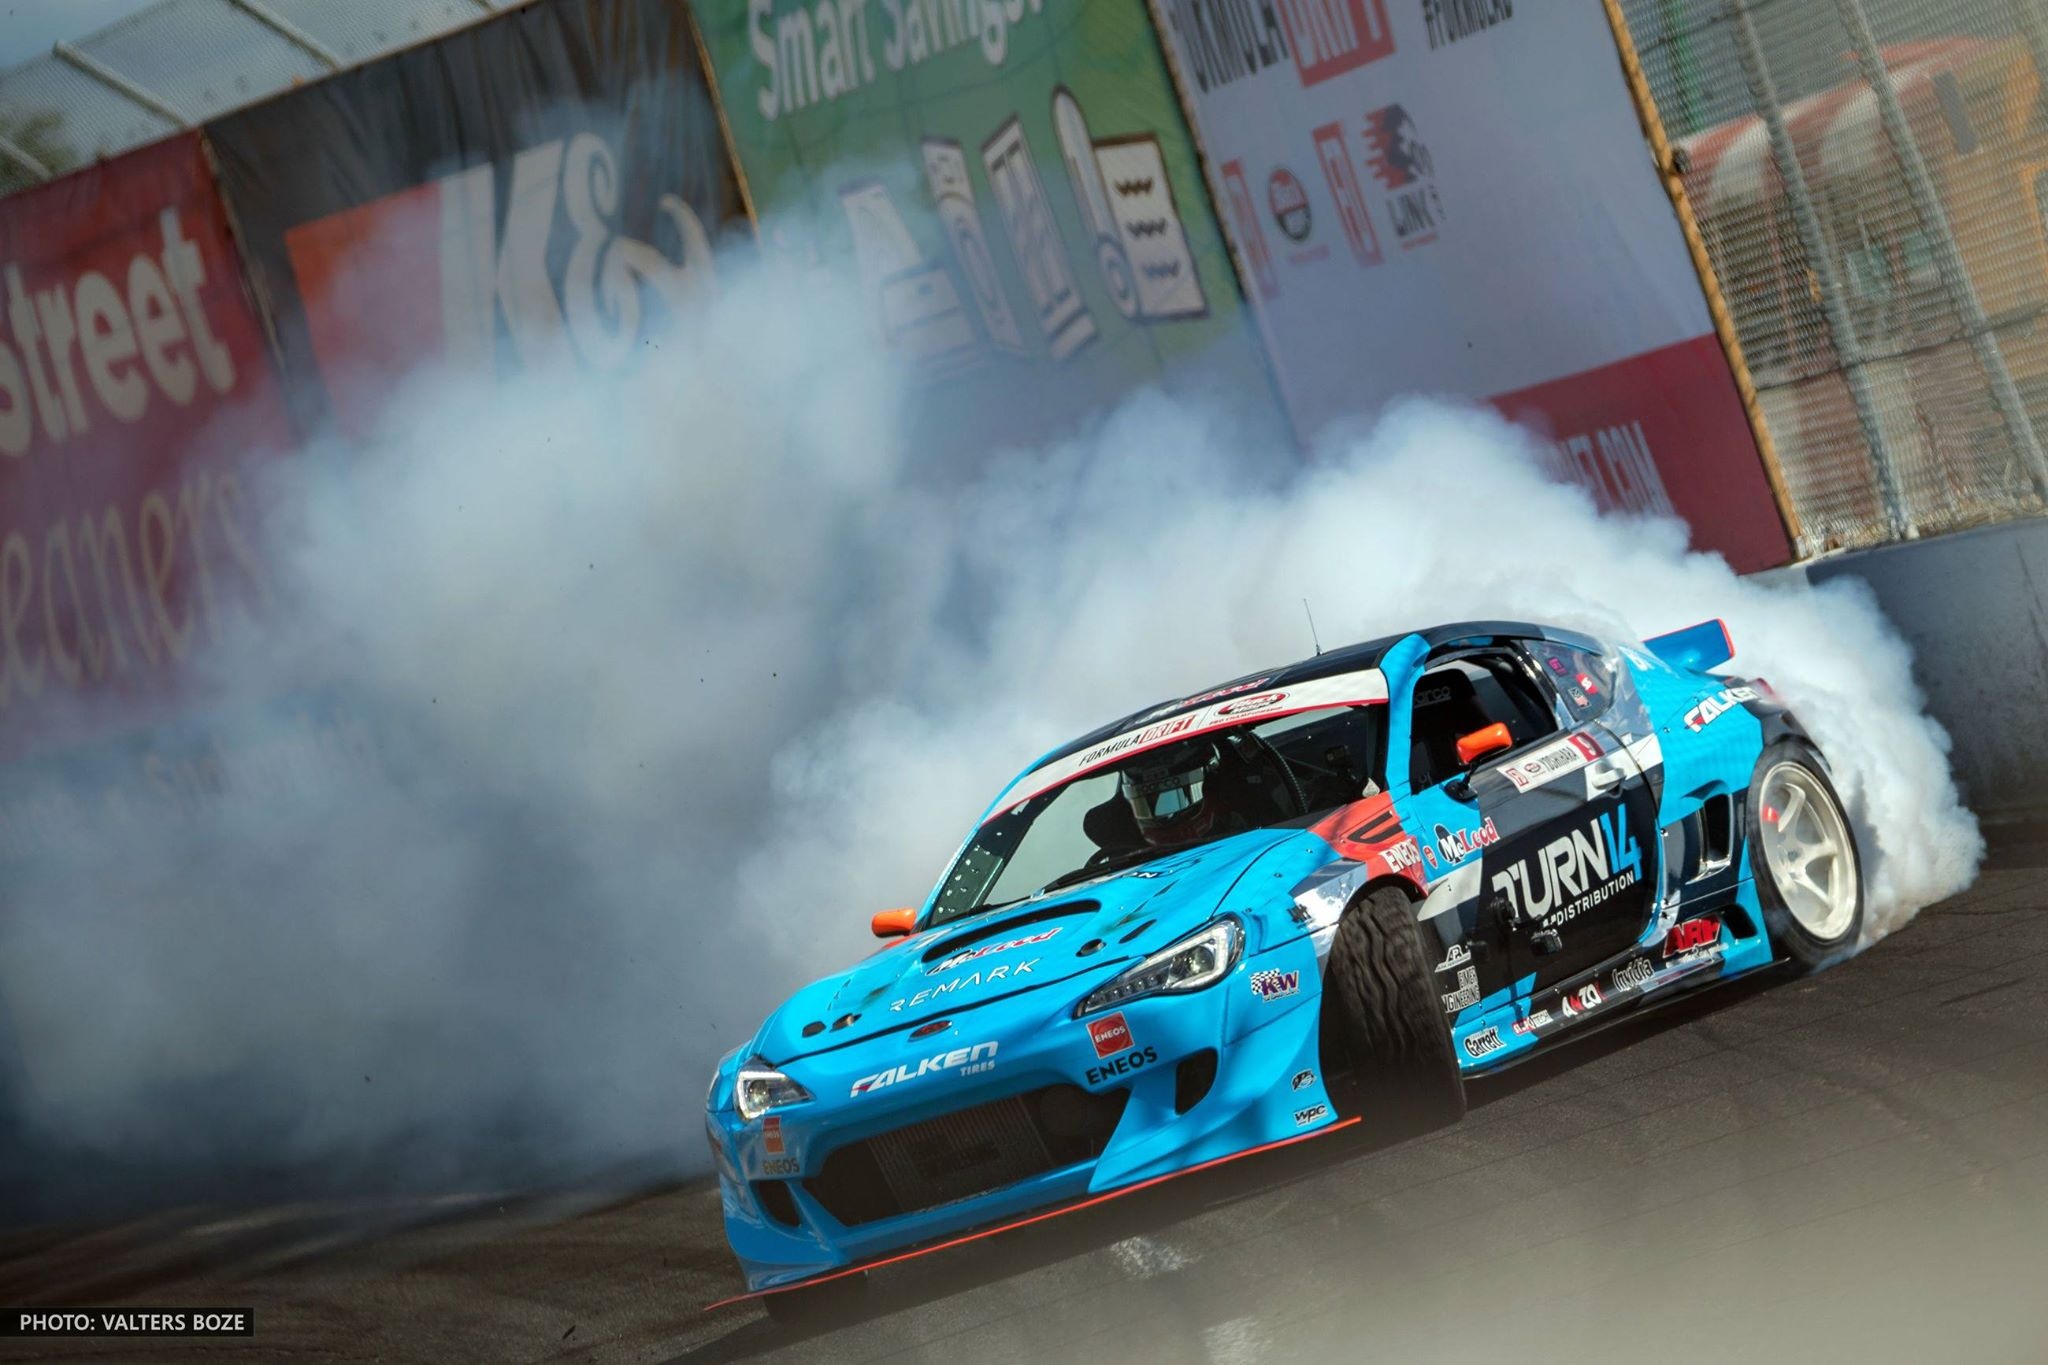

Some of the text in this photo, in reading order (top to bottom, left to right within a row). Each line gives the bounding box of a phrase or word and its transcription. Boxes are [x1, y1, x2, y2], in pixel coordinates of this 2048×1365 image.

[1078, 733, 1141, 768] FORMULA
[1439, 815, 1501, 864] McLeod
[1556, 870, 1635, 927] DISTRIBUTION
[888, 956, 1044, 1012] REMARK
[1259, 968, 1298, 997] KW
[1093, 1024, 1127, 1045] ENEOS
[1464, 1028, 1506, 1058] Garrett
[848, 1040, 1000, 1099] FALKEN
[959, 1060, 996, 1077] TIRES
[1084, 1045, 1160, 1086] ENEOS
[762, 1156, 801, 1176] ENEOS
